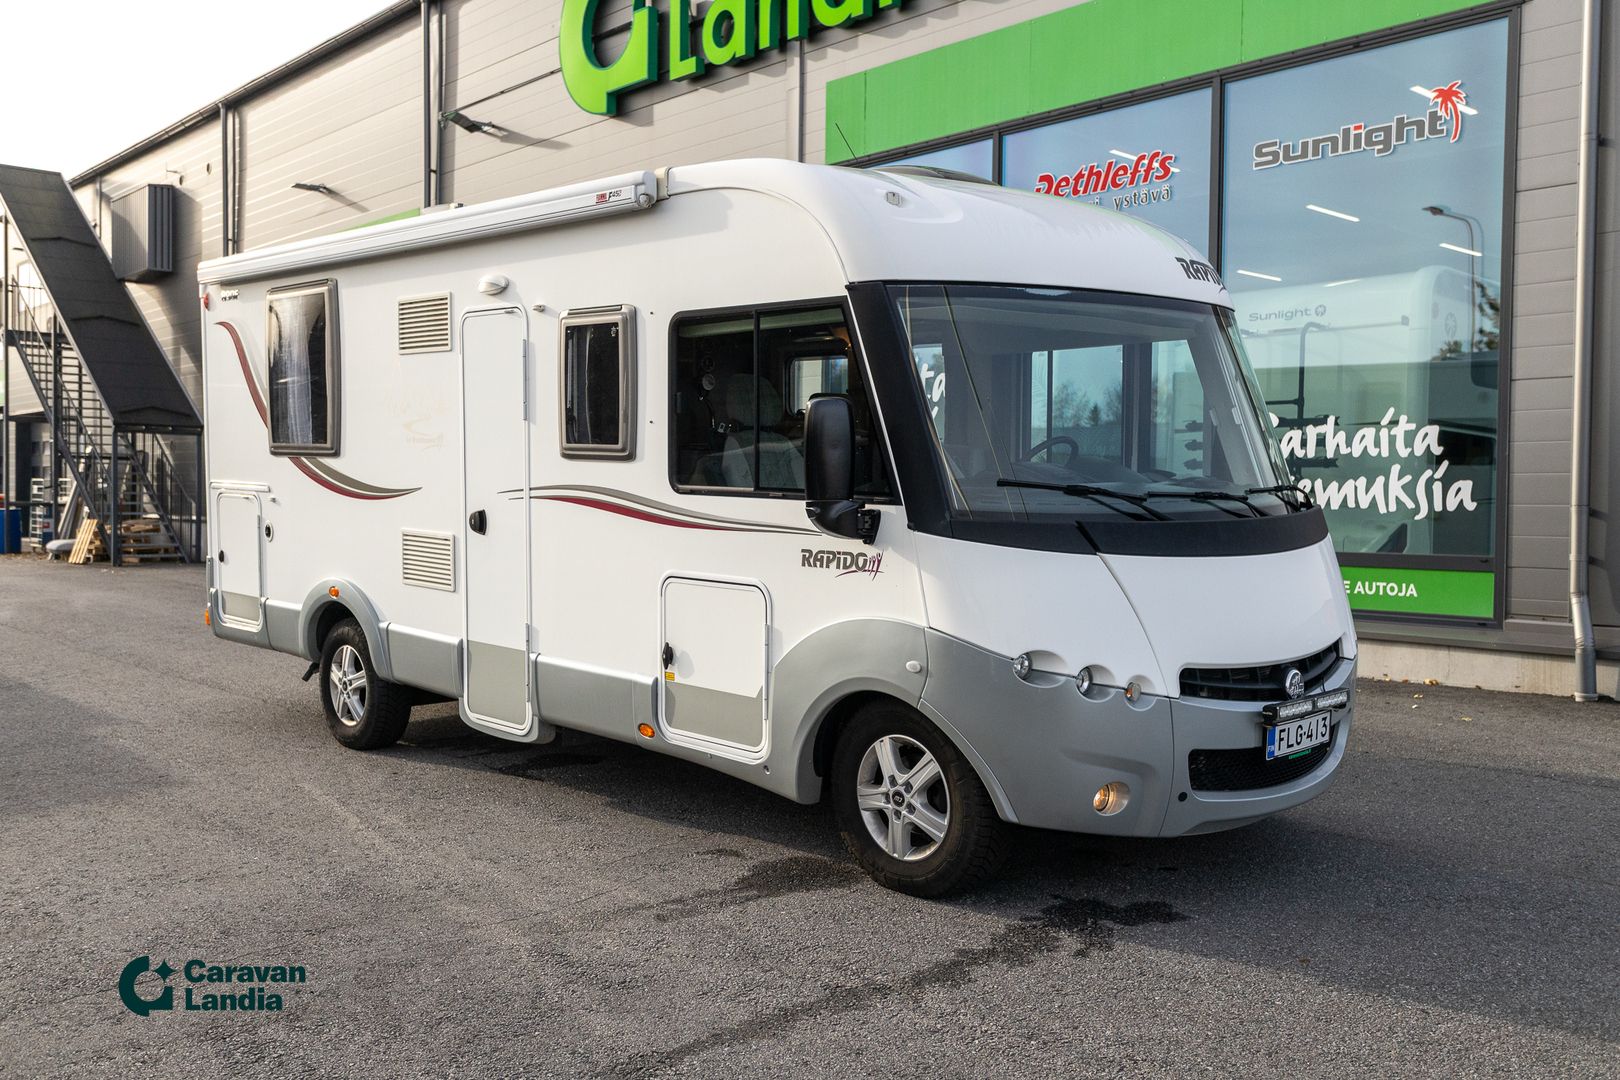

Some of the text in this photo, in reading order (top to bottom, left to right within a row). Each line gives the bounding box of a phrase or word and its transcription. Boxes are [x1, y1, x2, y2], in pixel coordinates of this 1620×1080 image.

[1252, 108, 1447, 170] Sunlight
[1113, 184, 1172, 211] ystävä
[1249, 307, 1312, 322] Sunlight
[1268, 407, 1444, 459] arhaita
[1353, 581, 1418, 598] AUTOJA
[1278, 716, 1329, 751] FLG-413
